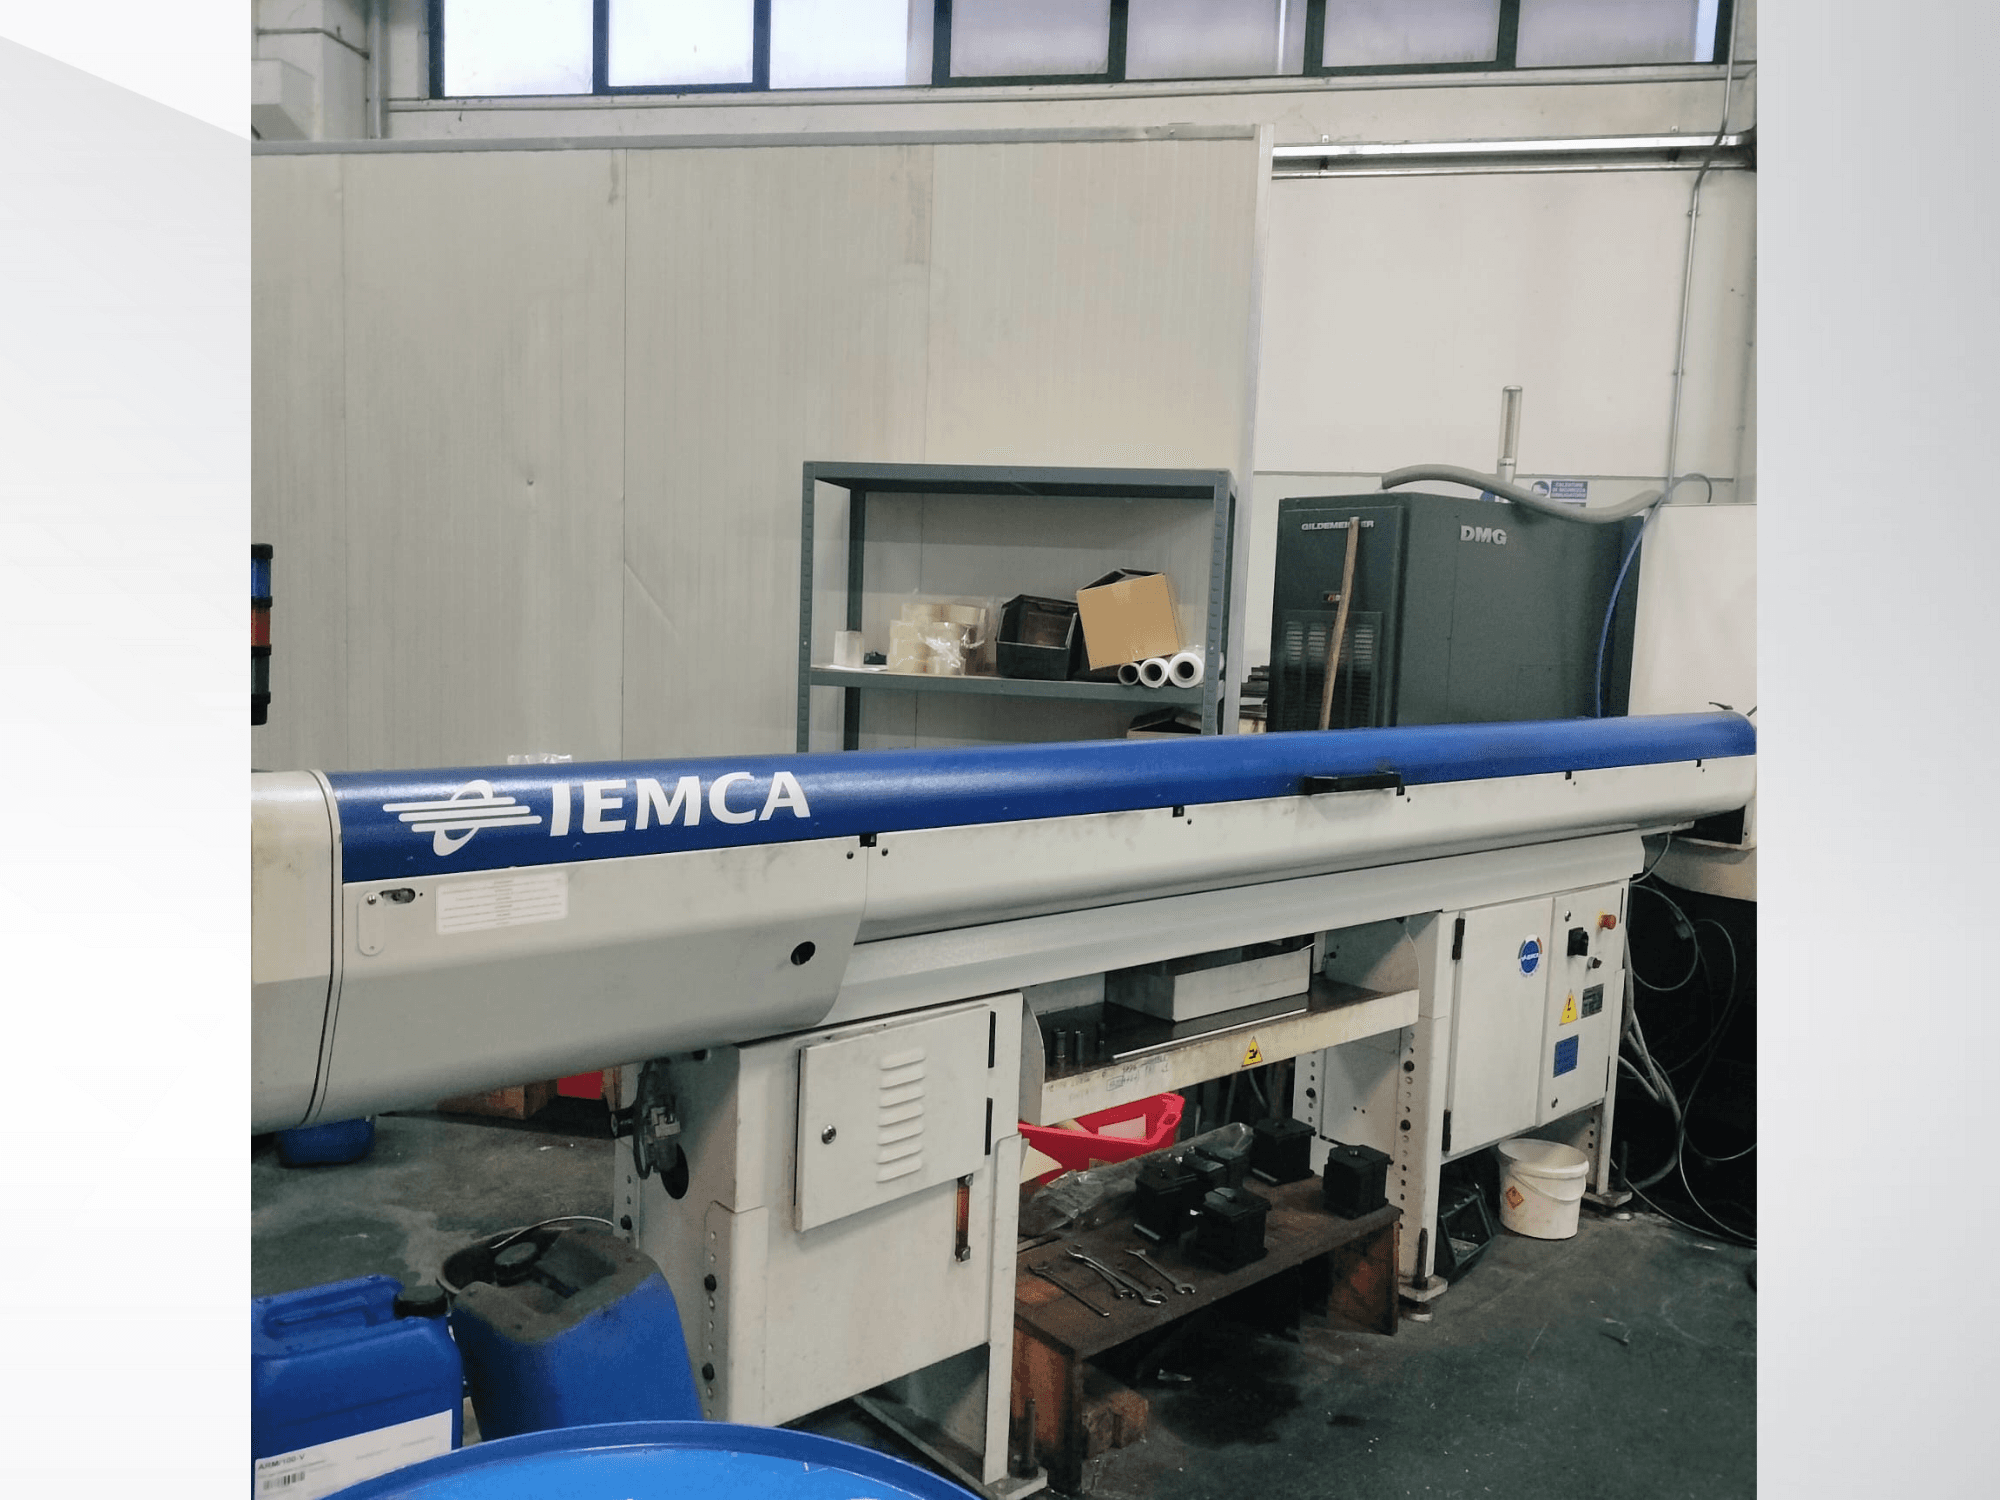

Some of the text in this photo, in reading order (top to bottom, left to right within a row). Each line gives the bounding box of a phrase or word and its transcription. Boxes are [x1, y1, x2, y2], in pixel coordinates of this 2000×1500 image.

[1301, 520, 1375, 531] GILDEMEIER
[1460, 525, 1507, 545] DMG
[549, 771, 811, 837] IEMCA
